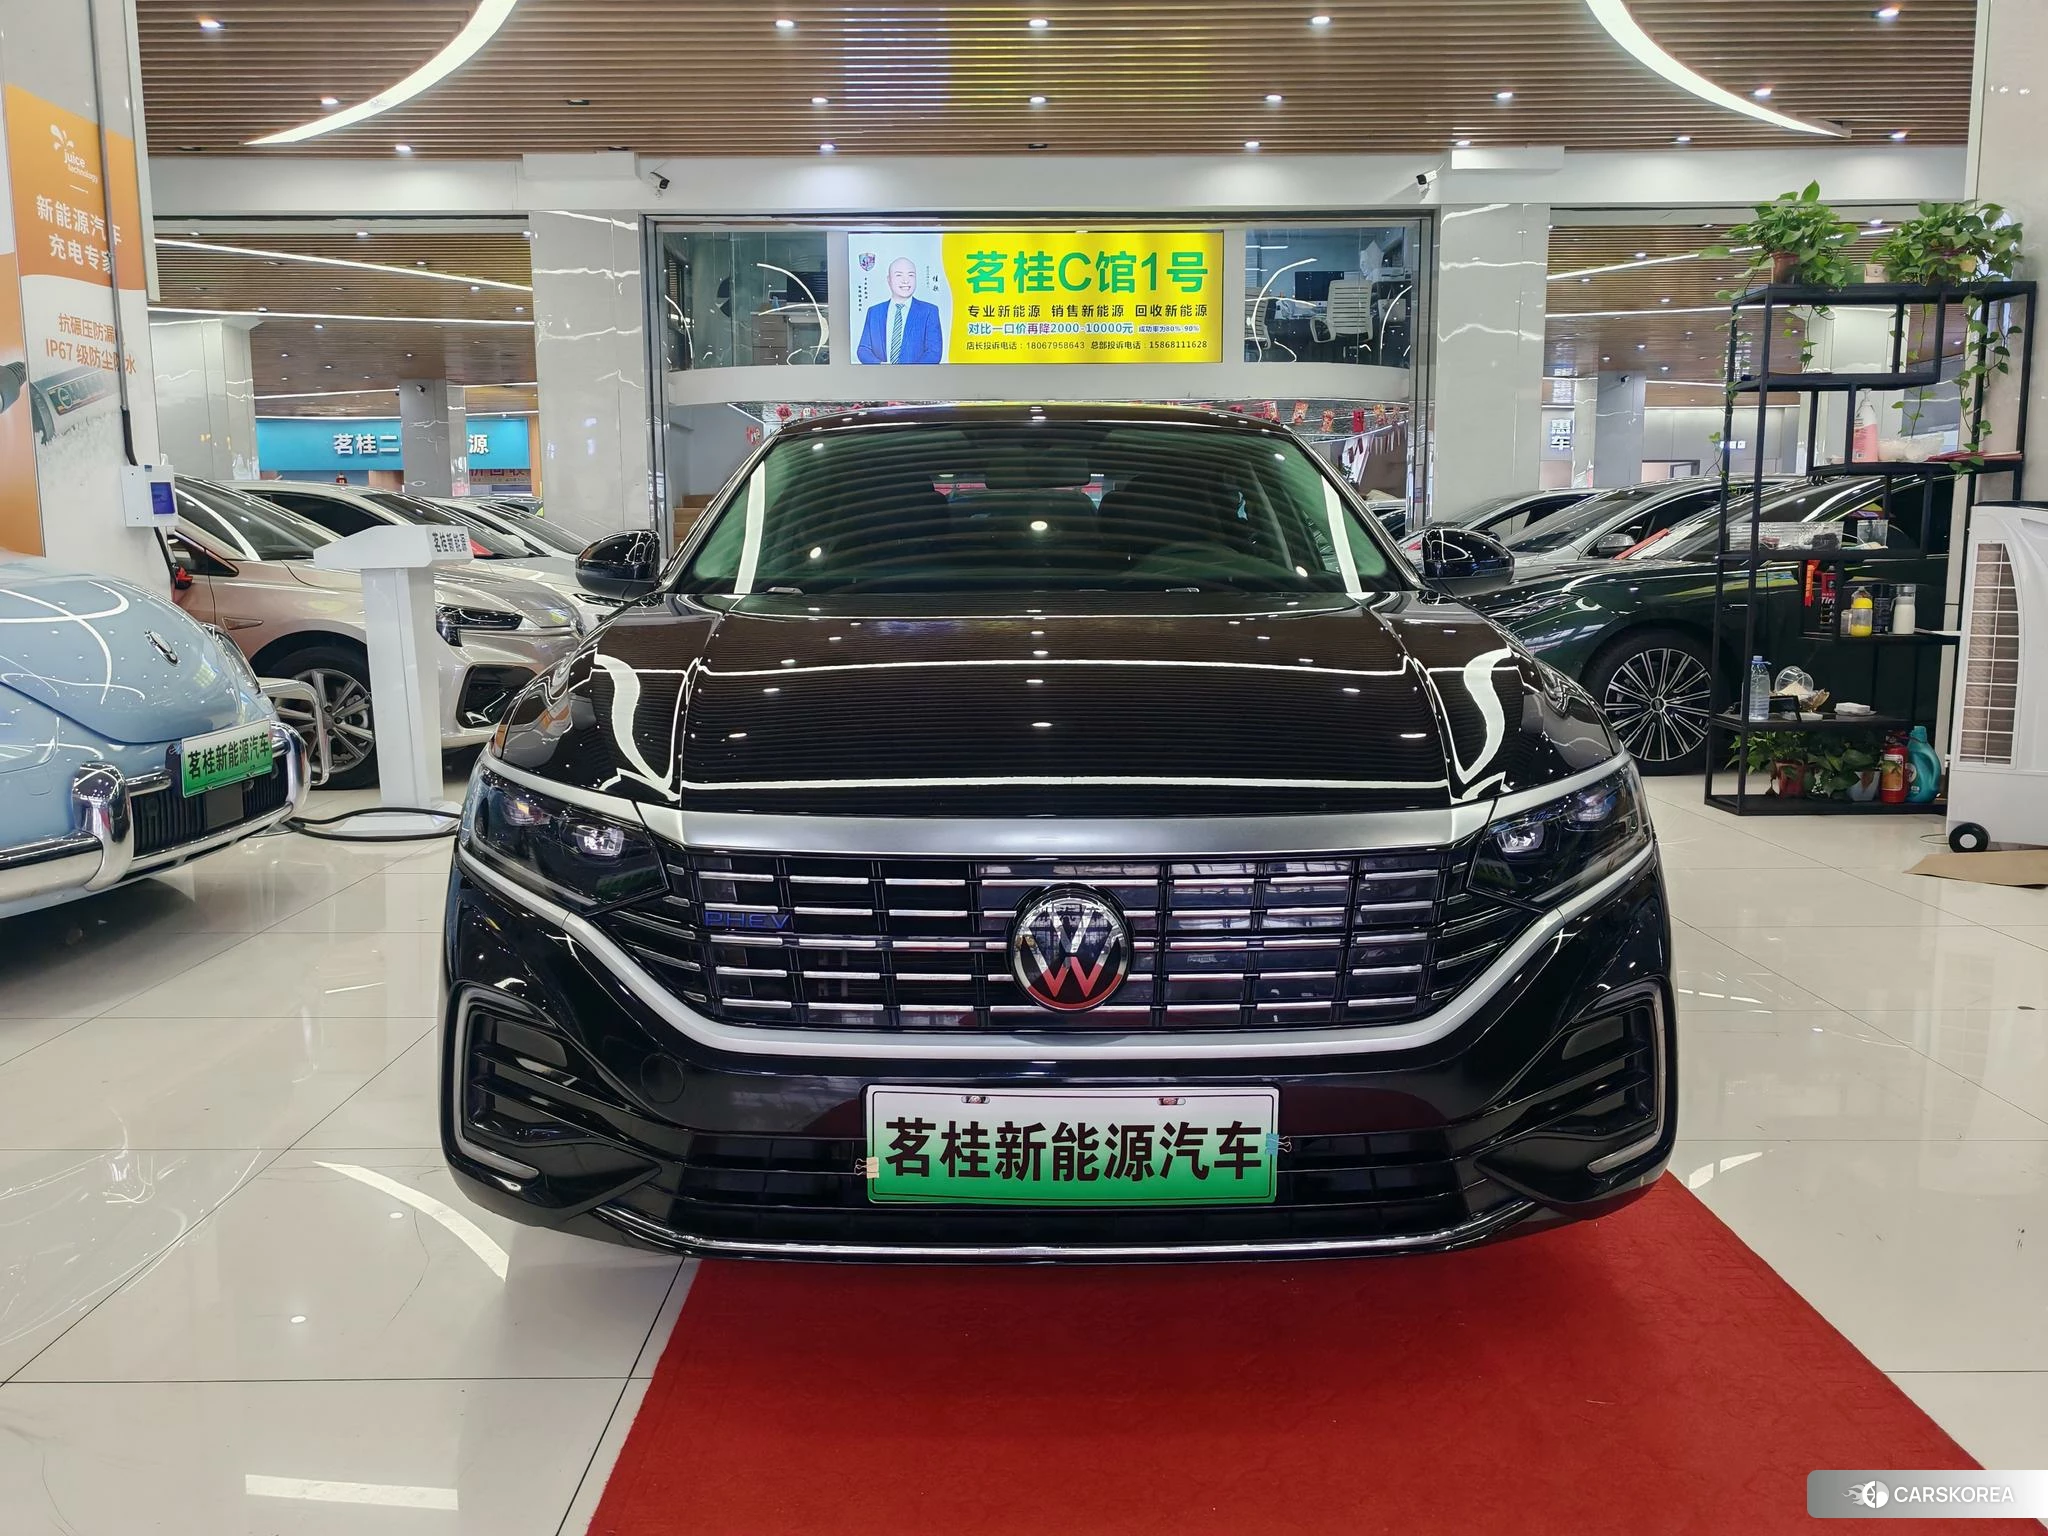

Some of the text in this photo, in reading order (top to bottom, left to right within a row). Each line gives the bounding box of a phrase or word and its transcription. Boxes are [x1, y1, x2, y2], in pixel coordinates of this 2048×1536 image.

[966, 250, 1209, 294] 茗桂C馆1号
[968, 304, 1208, 318] 专业新能源 销售新能源 回收新能源
[58, 313, 126, 347] 抗碾压防漏
[45, 338, 73, 361] IP67
[187, 731, 270, 781] 茗桂新能源汽车
[704, 911, 790, 929] PHEV
[885, 1116, 1263, 1182] 茗桂新能源汽车
